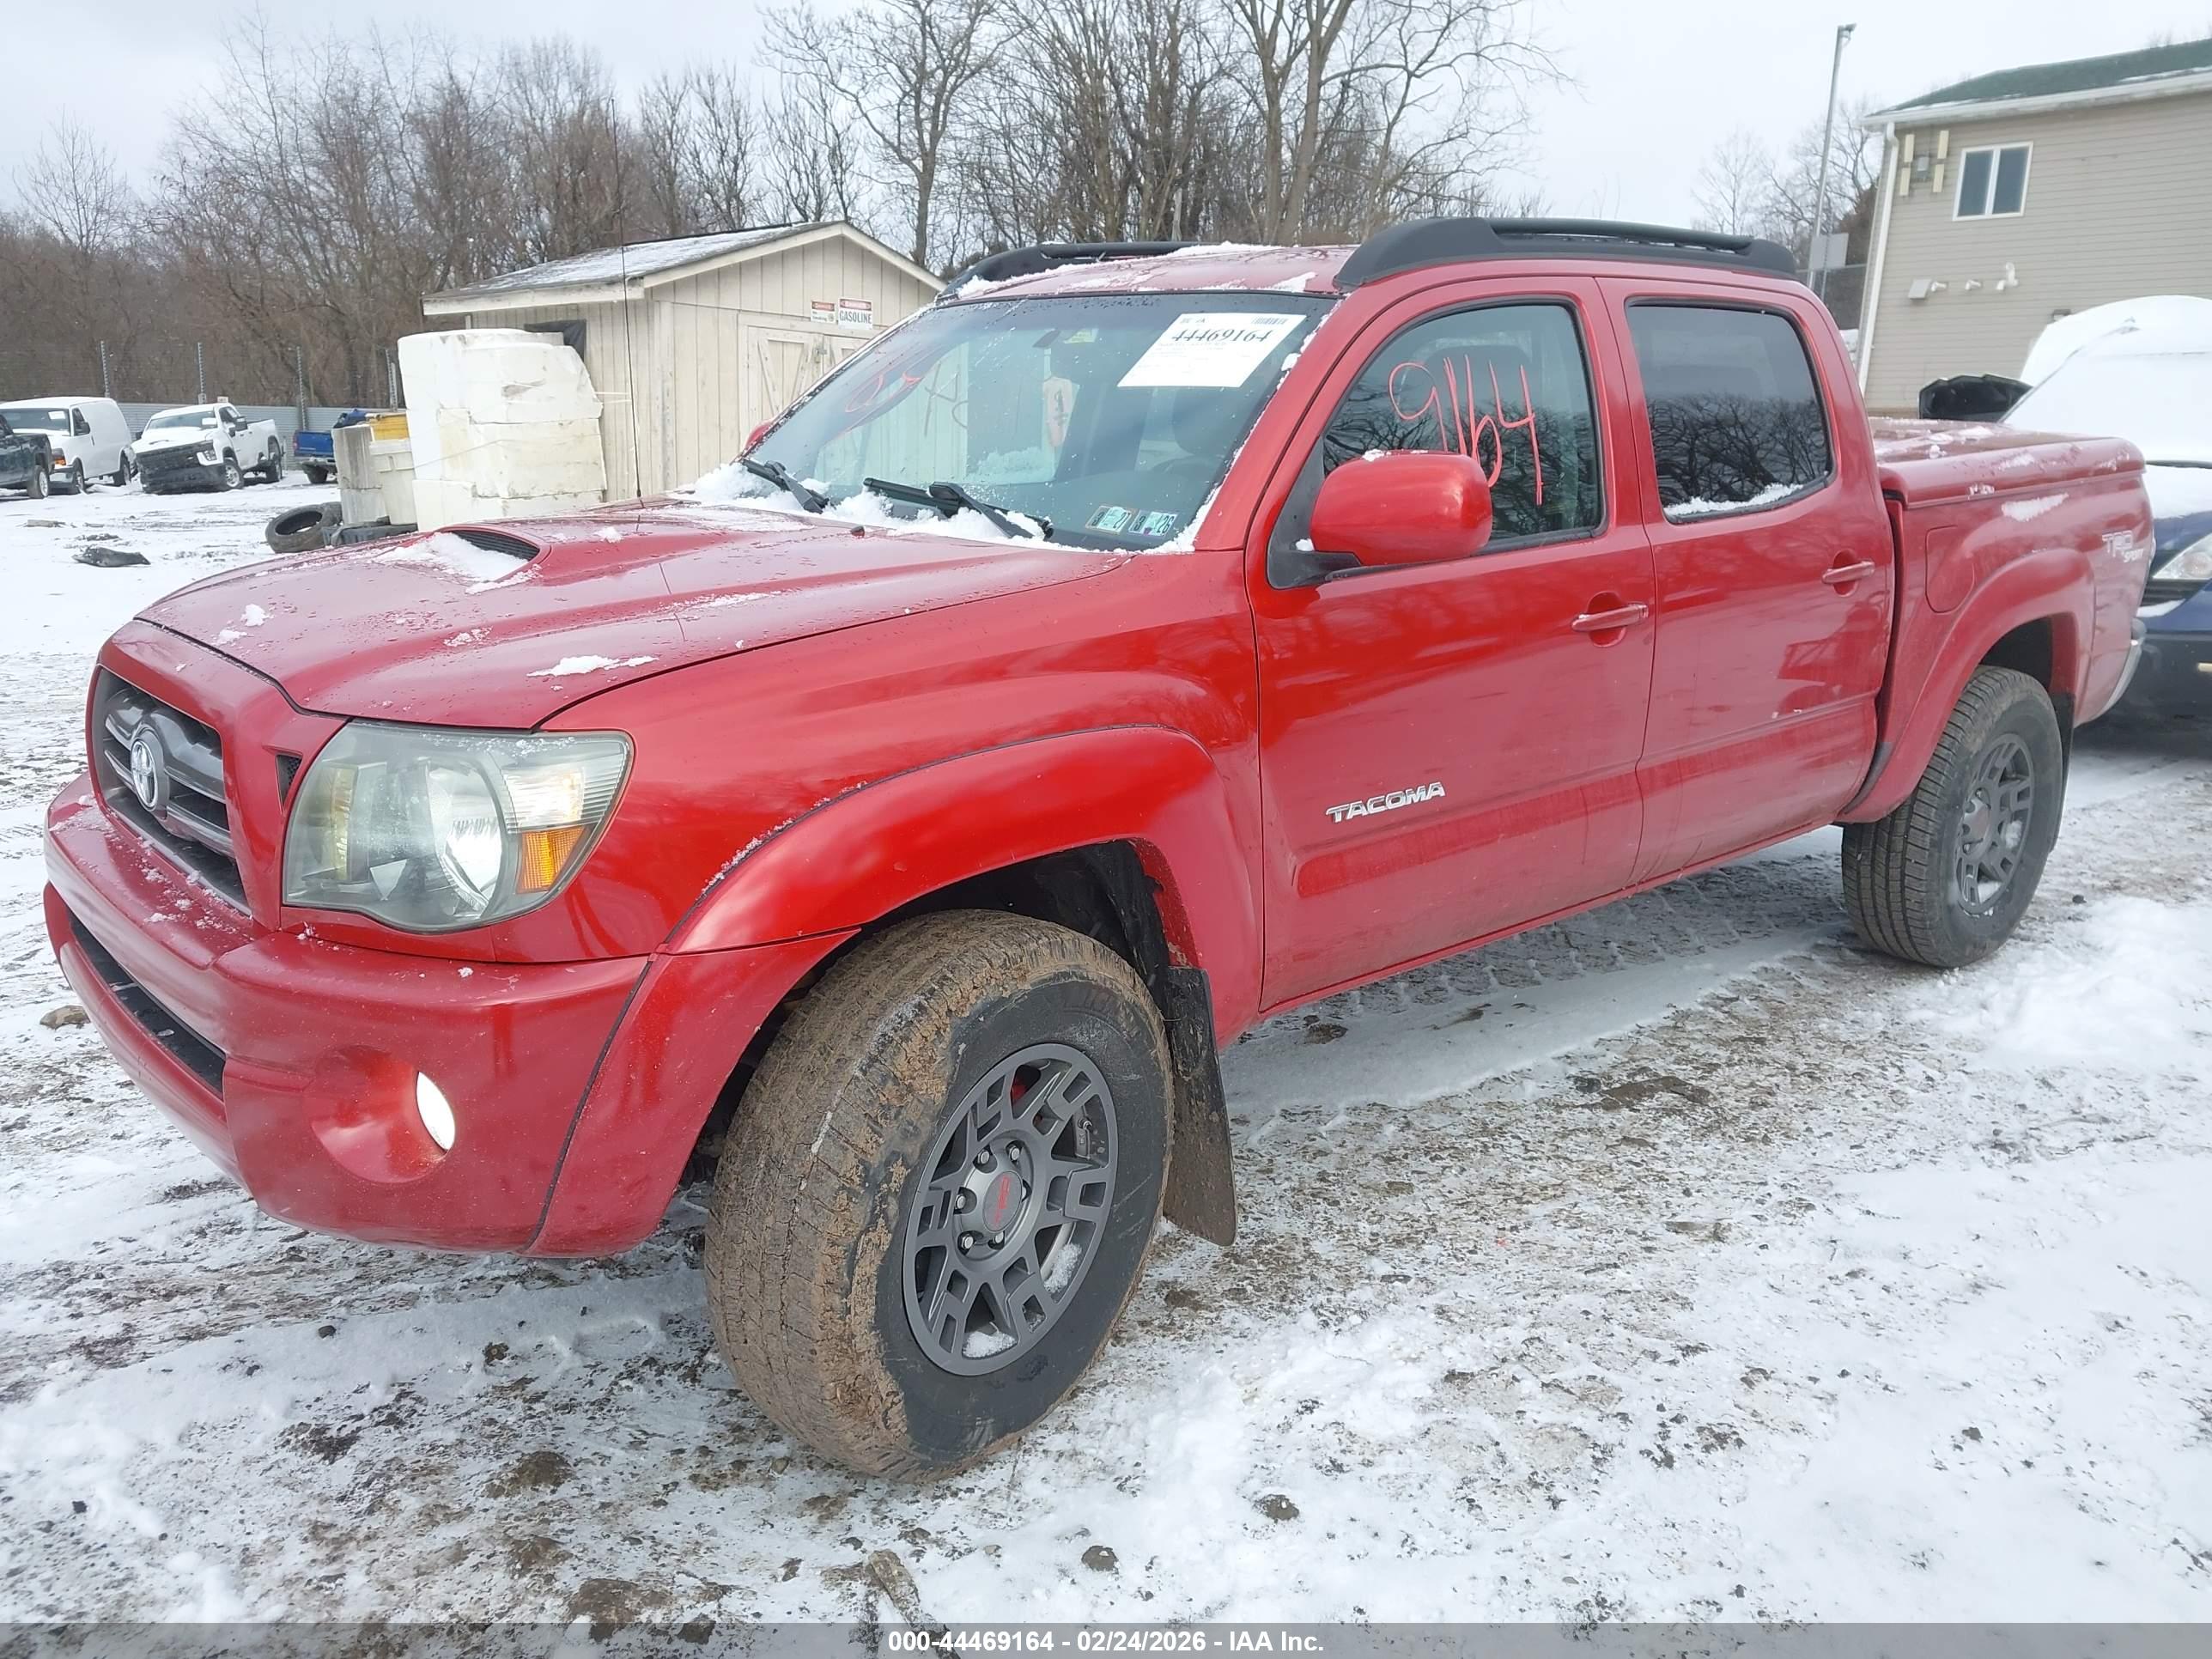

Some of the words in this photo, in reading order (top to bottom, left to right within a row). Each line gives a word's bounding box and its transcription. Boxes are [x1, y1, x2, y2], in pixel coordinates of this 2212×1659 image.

[839, 310, 872, 325] GASOLINE
[1171, 329, 1273, 342] 44469164
[1133, 515, 1146, 531] 3
[2102, 530, 2134, 557] TRD
[1326, 781, 1446, 823] TACOMA
